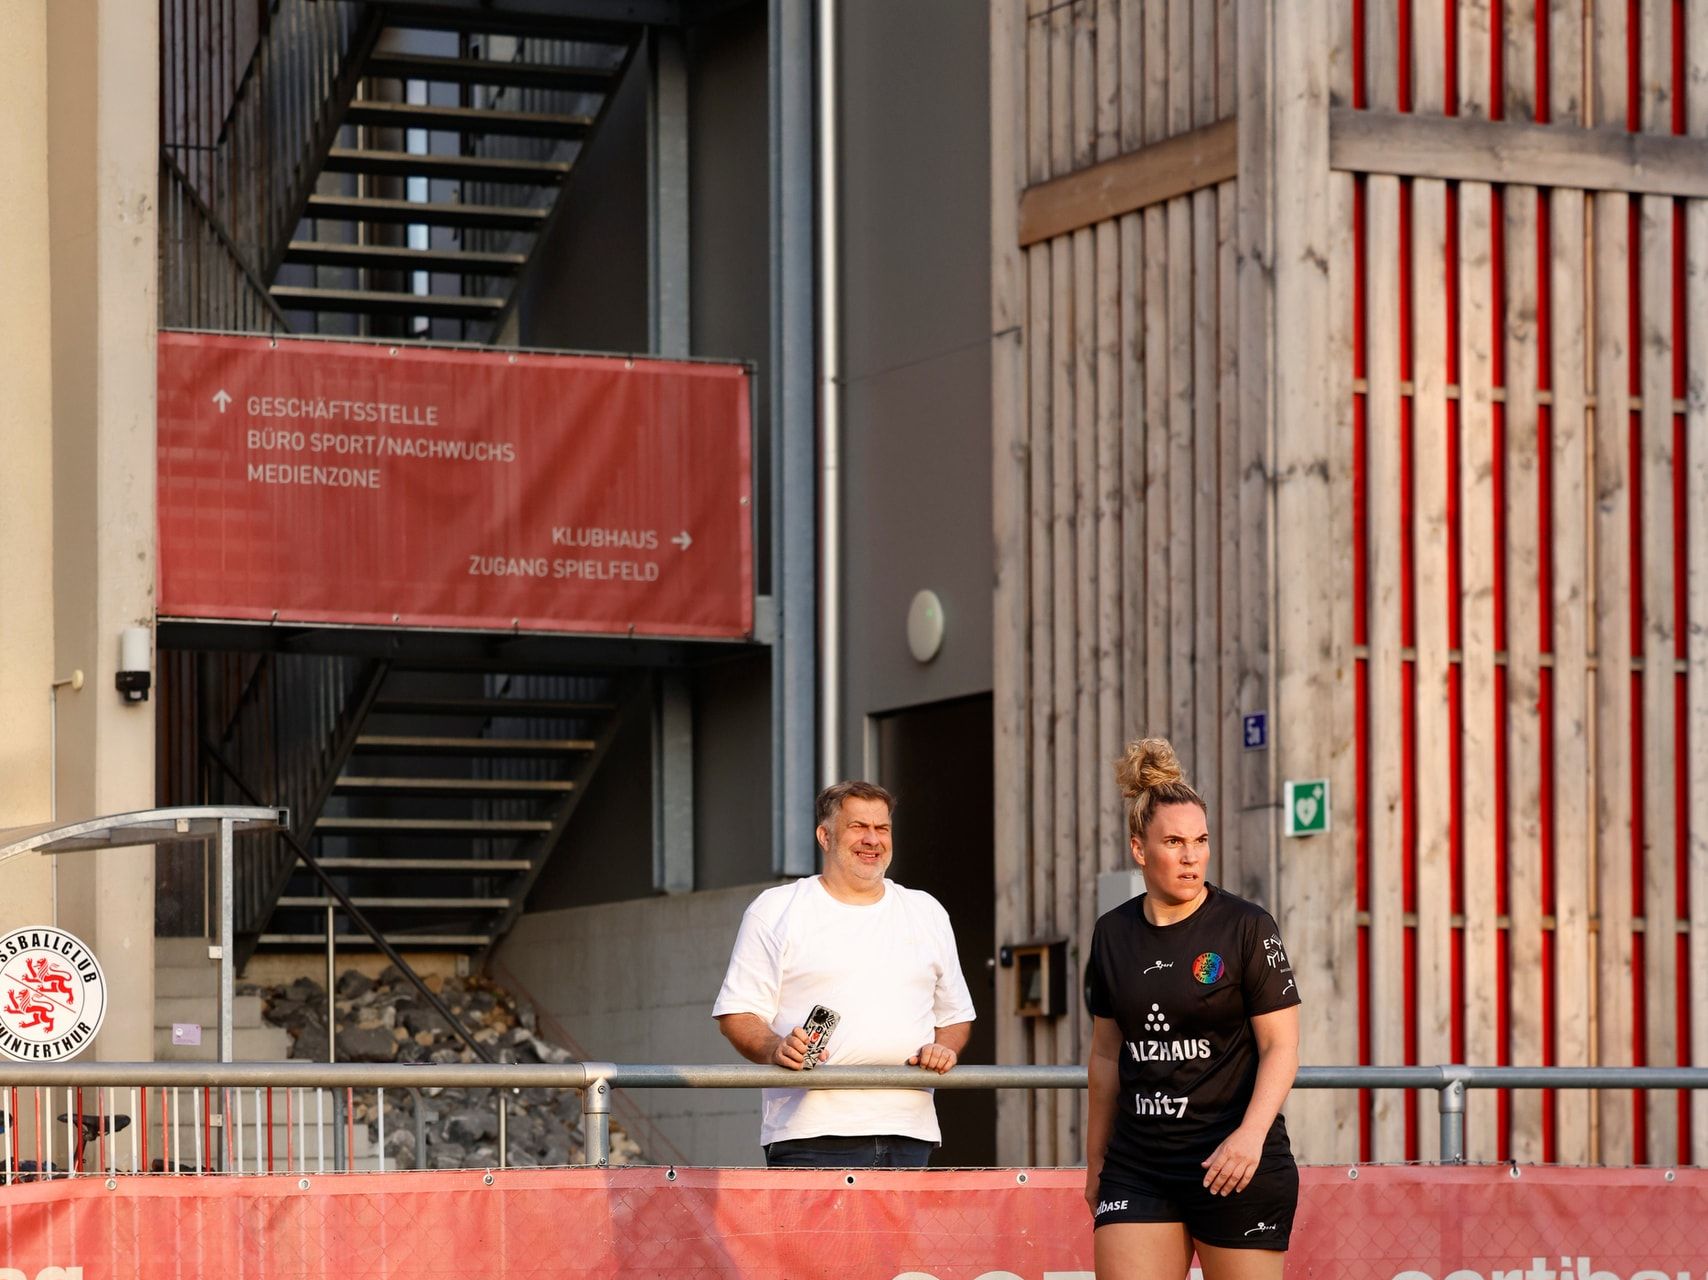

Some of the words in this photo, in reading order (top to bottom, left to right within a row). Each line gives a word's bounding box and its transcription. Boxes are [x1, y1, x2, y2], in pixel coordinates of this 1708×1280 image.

[246, 396, 439, 426] GESCHÄFTSSTELLE
[246, 427, 305, 451] BÜRO
[310, 432, 516, 462] SPORT/NACHWUCHS
[246, 463, 381, 488] MEDIENZONE
[551, 527, 659, 549] KLUBHAUS
[468, 555, 549, 577] ZUGANG
[552, 559, 660, 582] SPIELFELD
[1126, 1038, 1212, 1062] ALZHAUS
[1135, 1091, 1189, 1119] Init7
